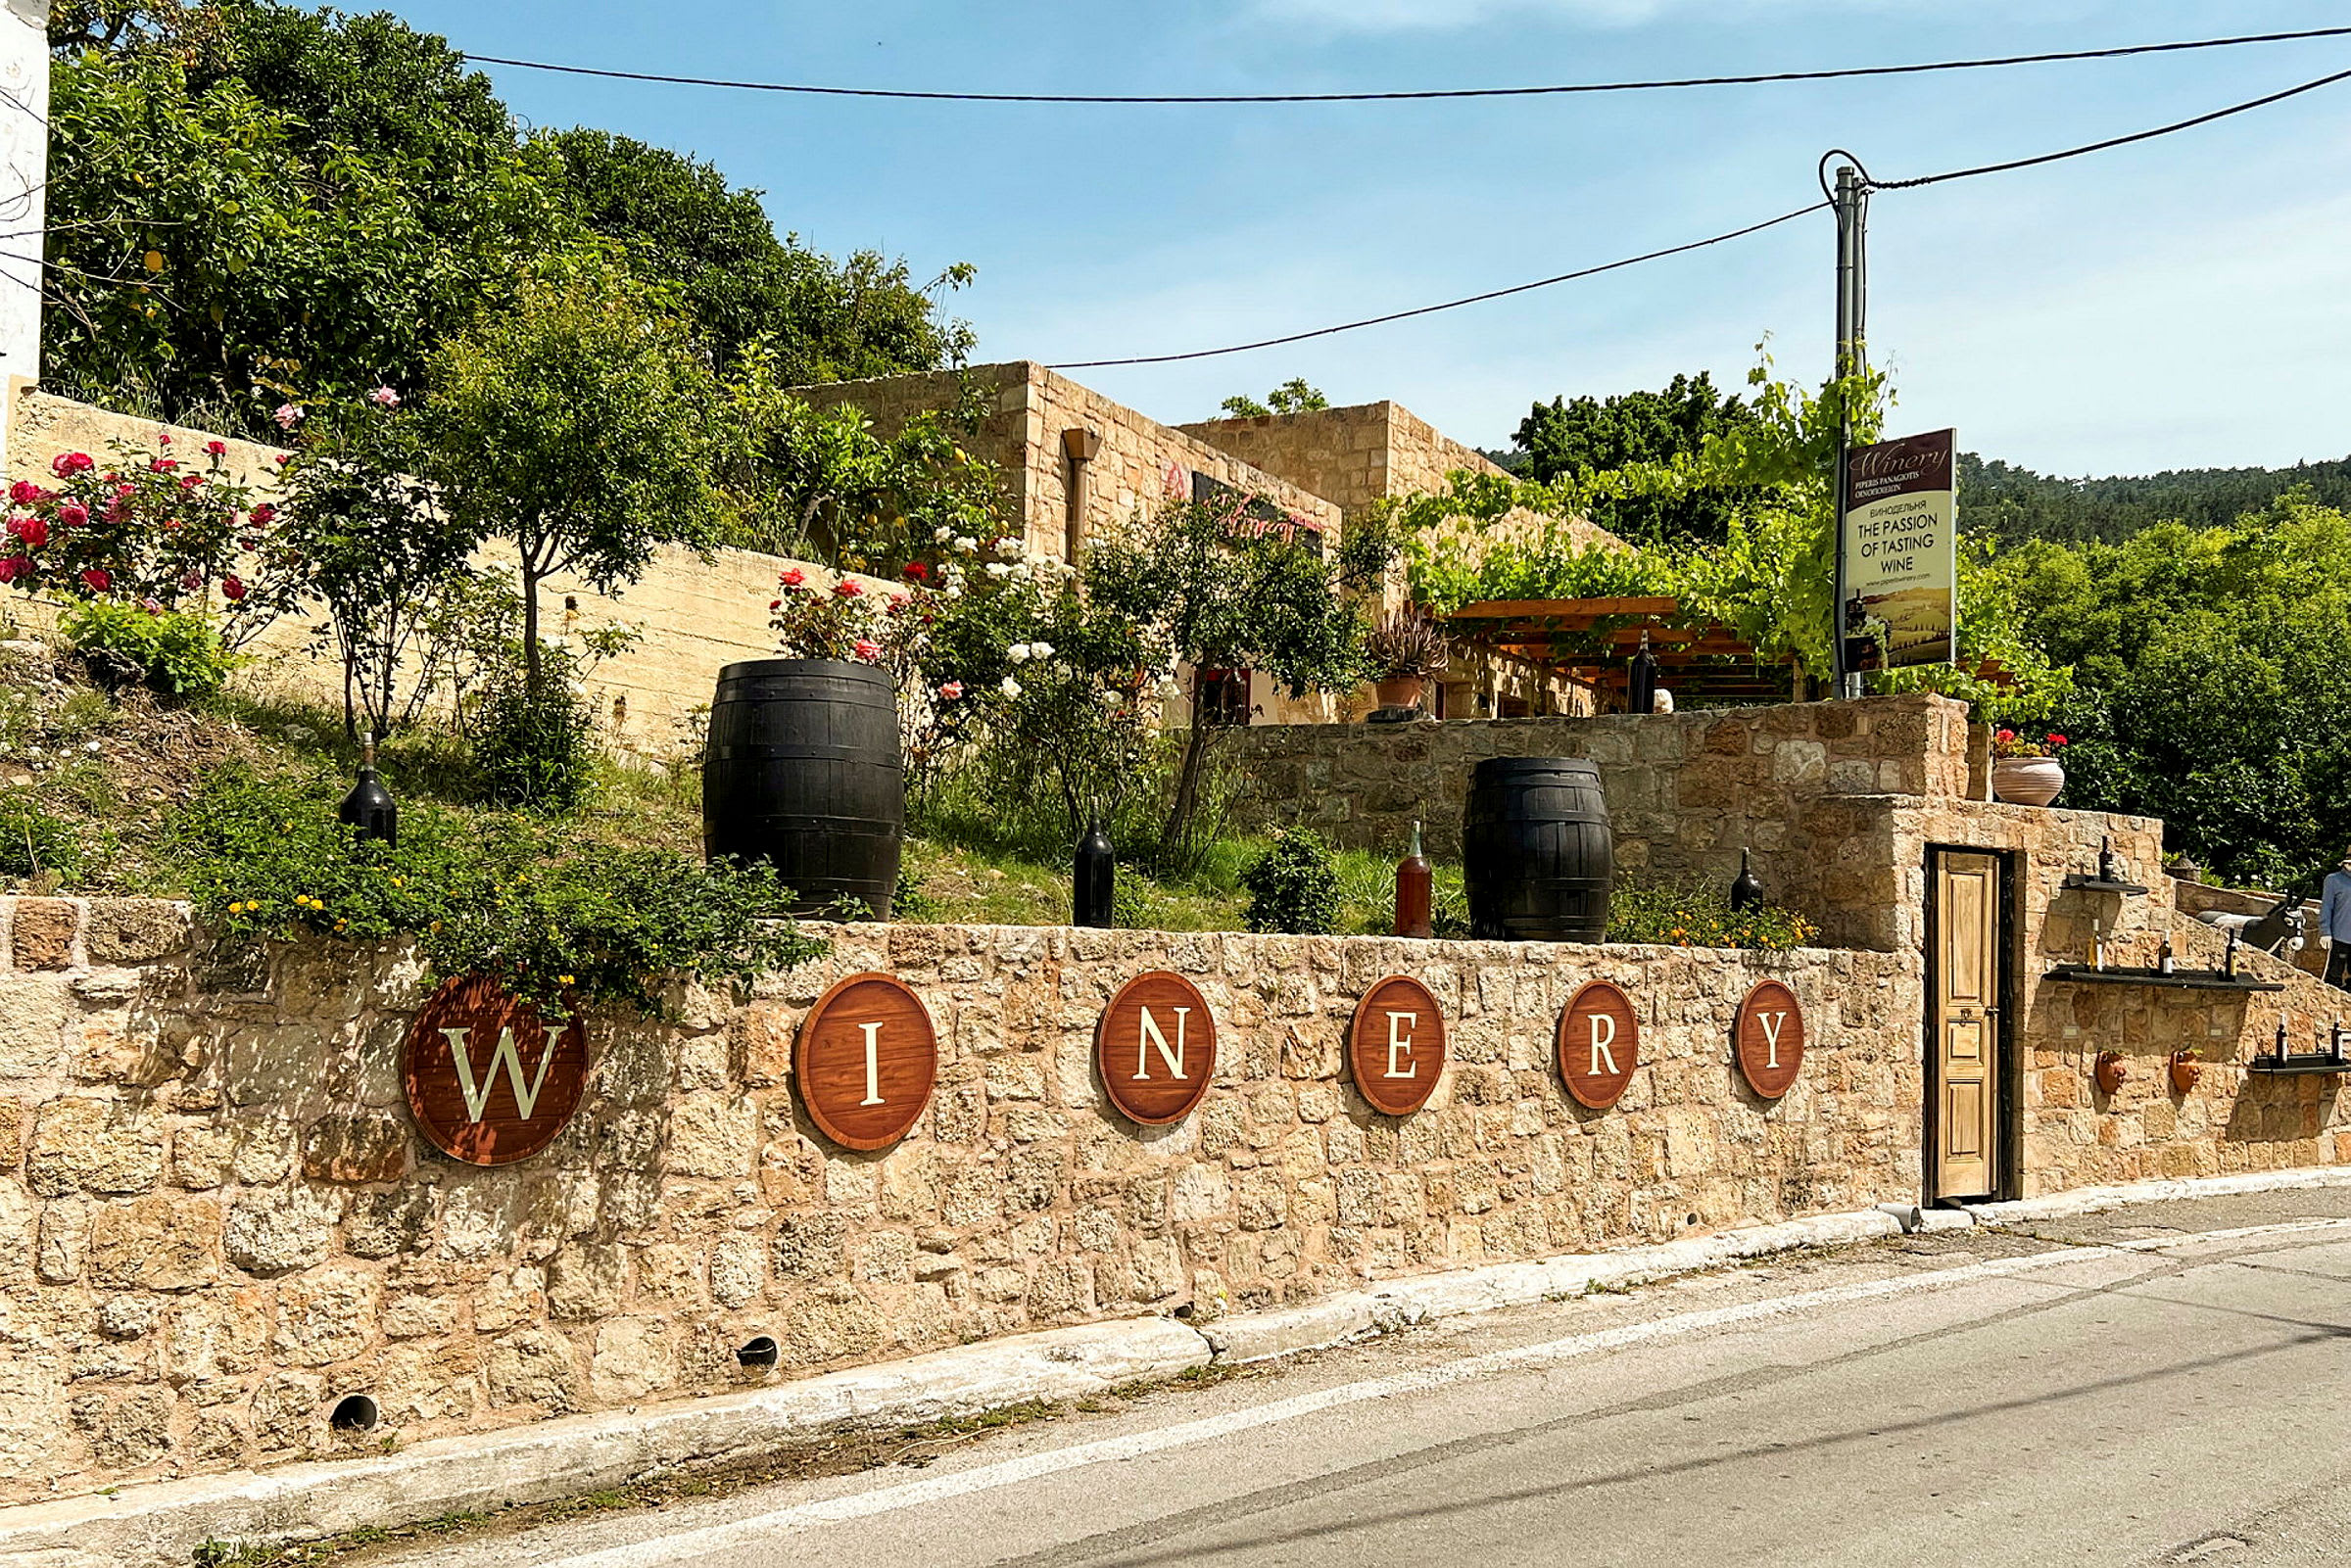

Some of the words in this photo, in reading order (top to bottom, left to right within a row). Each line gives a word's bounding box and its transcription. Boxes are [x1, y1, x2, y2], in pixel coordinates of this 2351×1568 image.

[1849, 443, 1949, 477] Winery
[1857, 522, 1880, 539] THE
[1883, 512, 1938, 535] PASSION
[1861, 542, 1880, 557] OF
[1882, 533, 1935, 555] TASTING
[1881, 556, 1913, 574] WINE
[438, 1025, 569, 1123] W
[857, 1022, 886, 1107] I
[1131, 1006, 1192, 1080] N
[1382, 1011, 1417, 1078] E
[1587, 1014, 1621, 1076] R
[1755, 1011, 1787, 1069] Y
